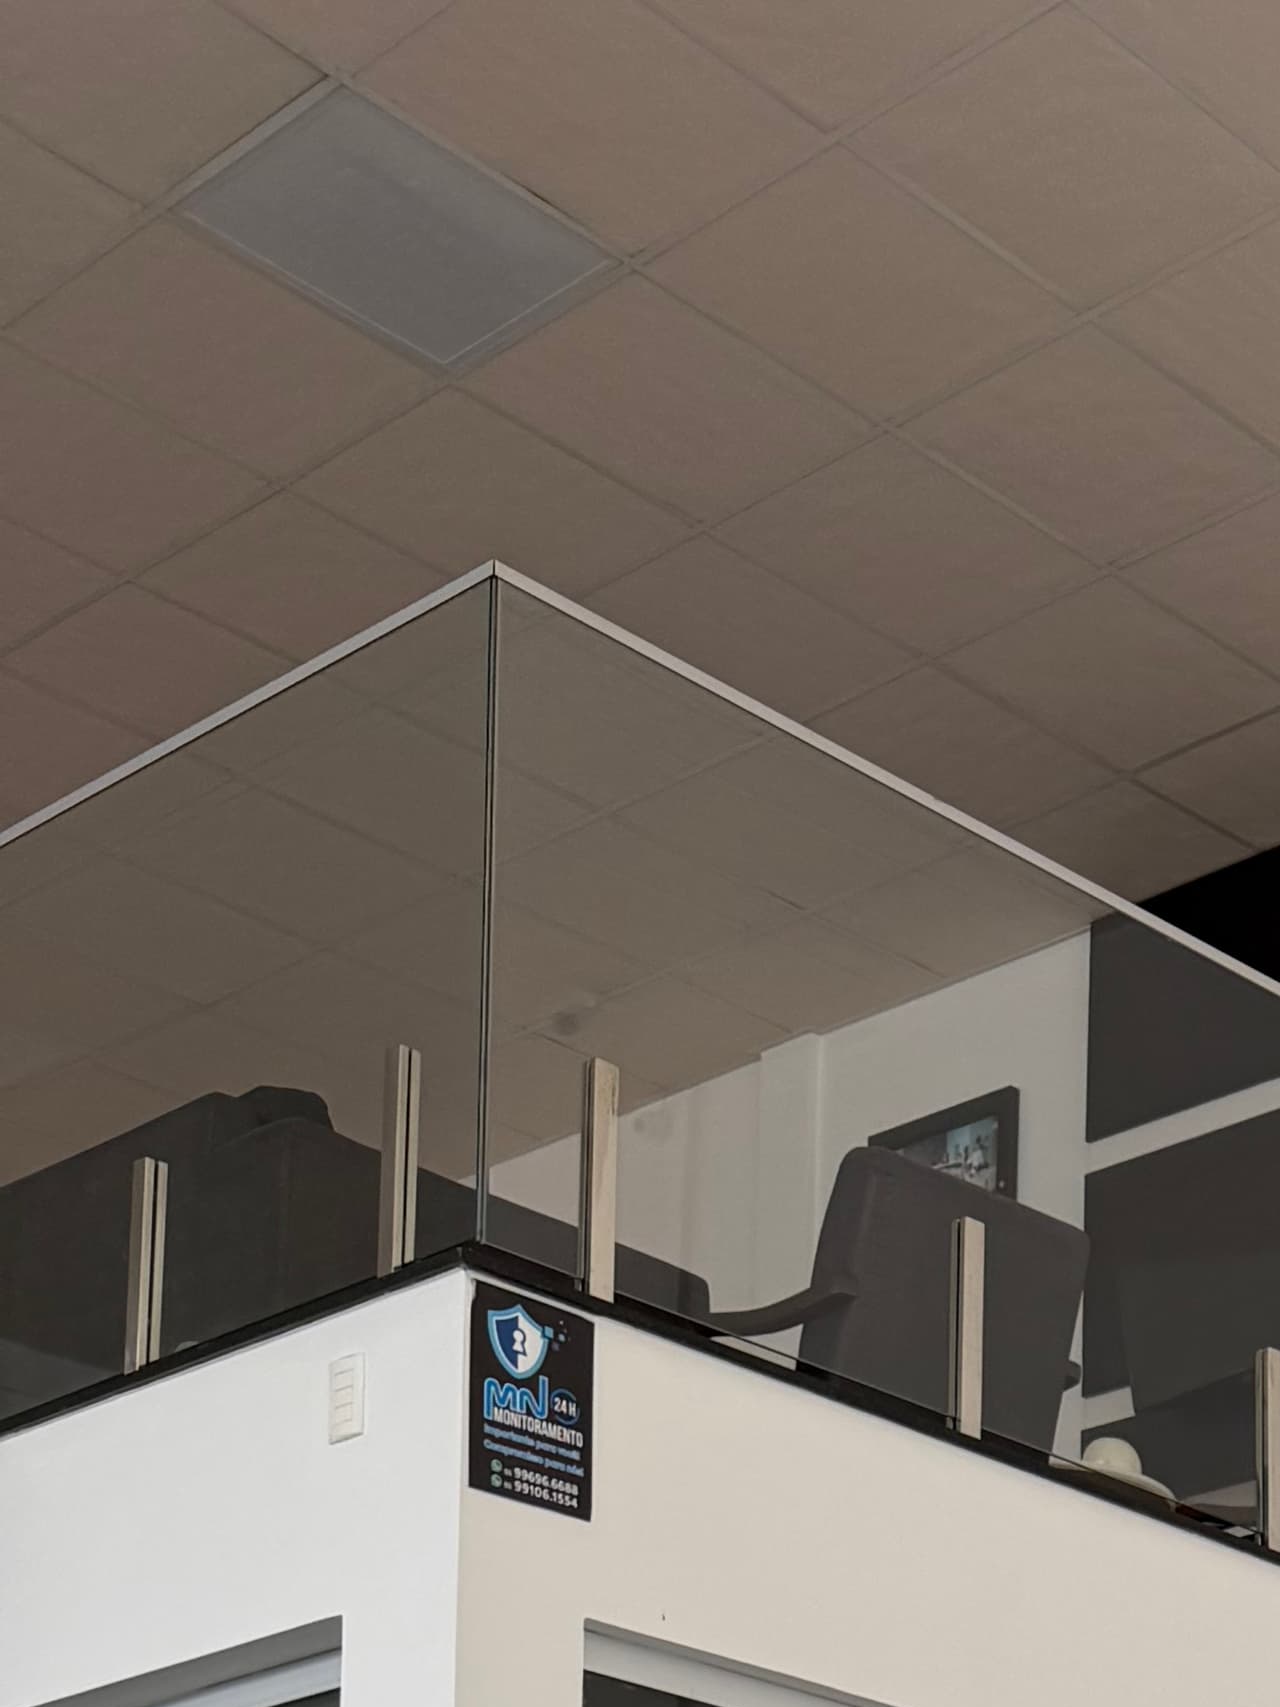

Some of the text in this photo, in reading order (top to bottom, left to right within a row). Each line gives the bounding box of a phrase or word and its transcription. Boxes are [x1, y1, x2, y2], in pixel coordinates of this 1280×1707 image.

[483, 1375, 549, 1420] MN
[554, 1397, 577, 1417] 24 H
[493, 1407, 584, 1448] MONITORAMENTO
